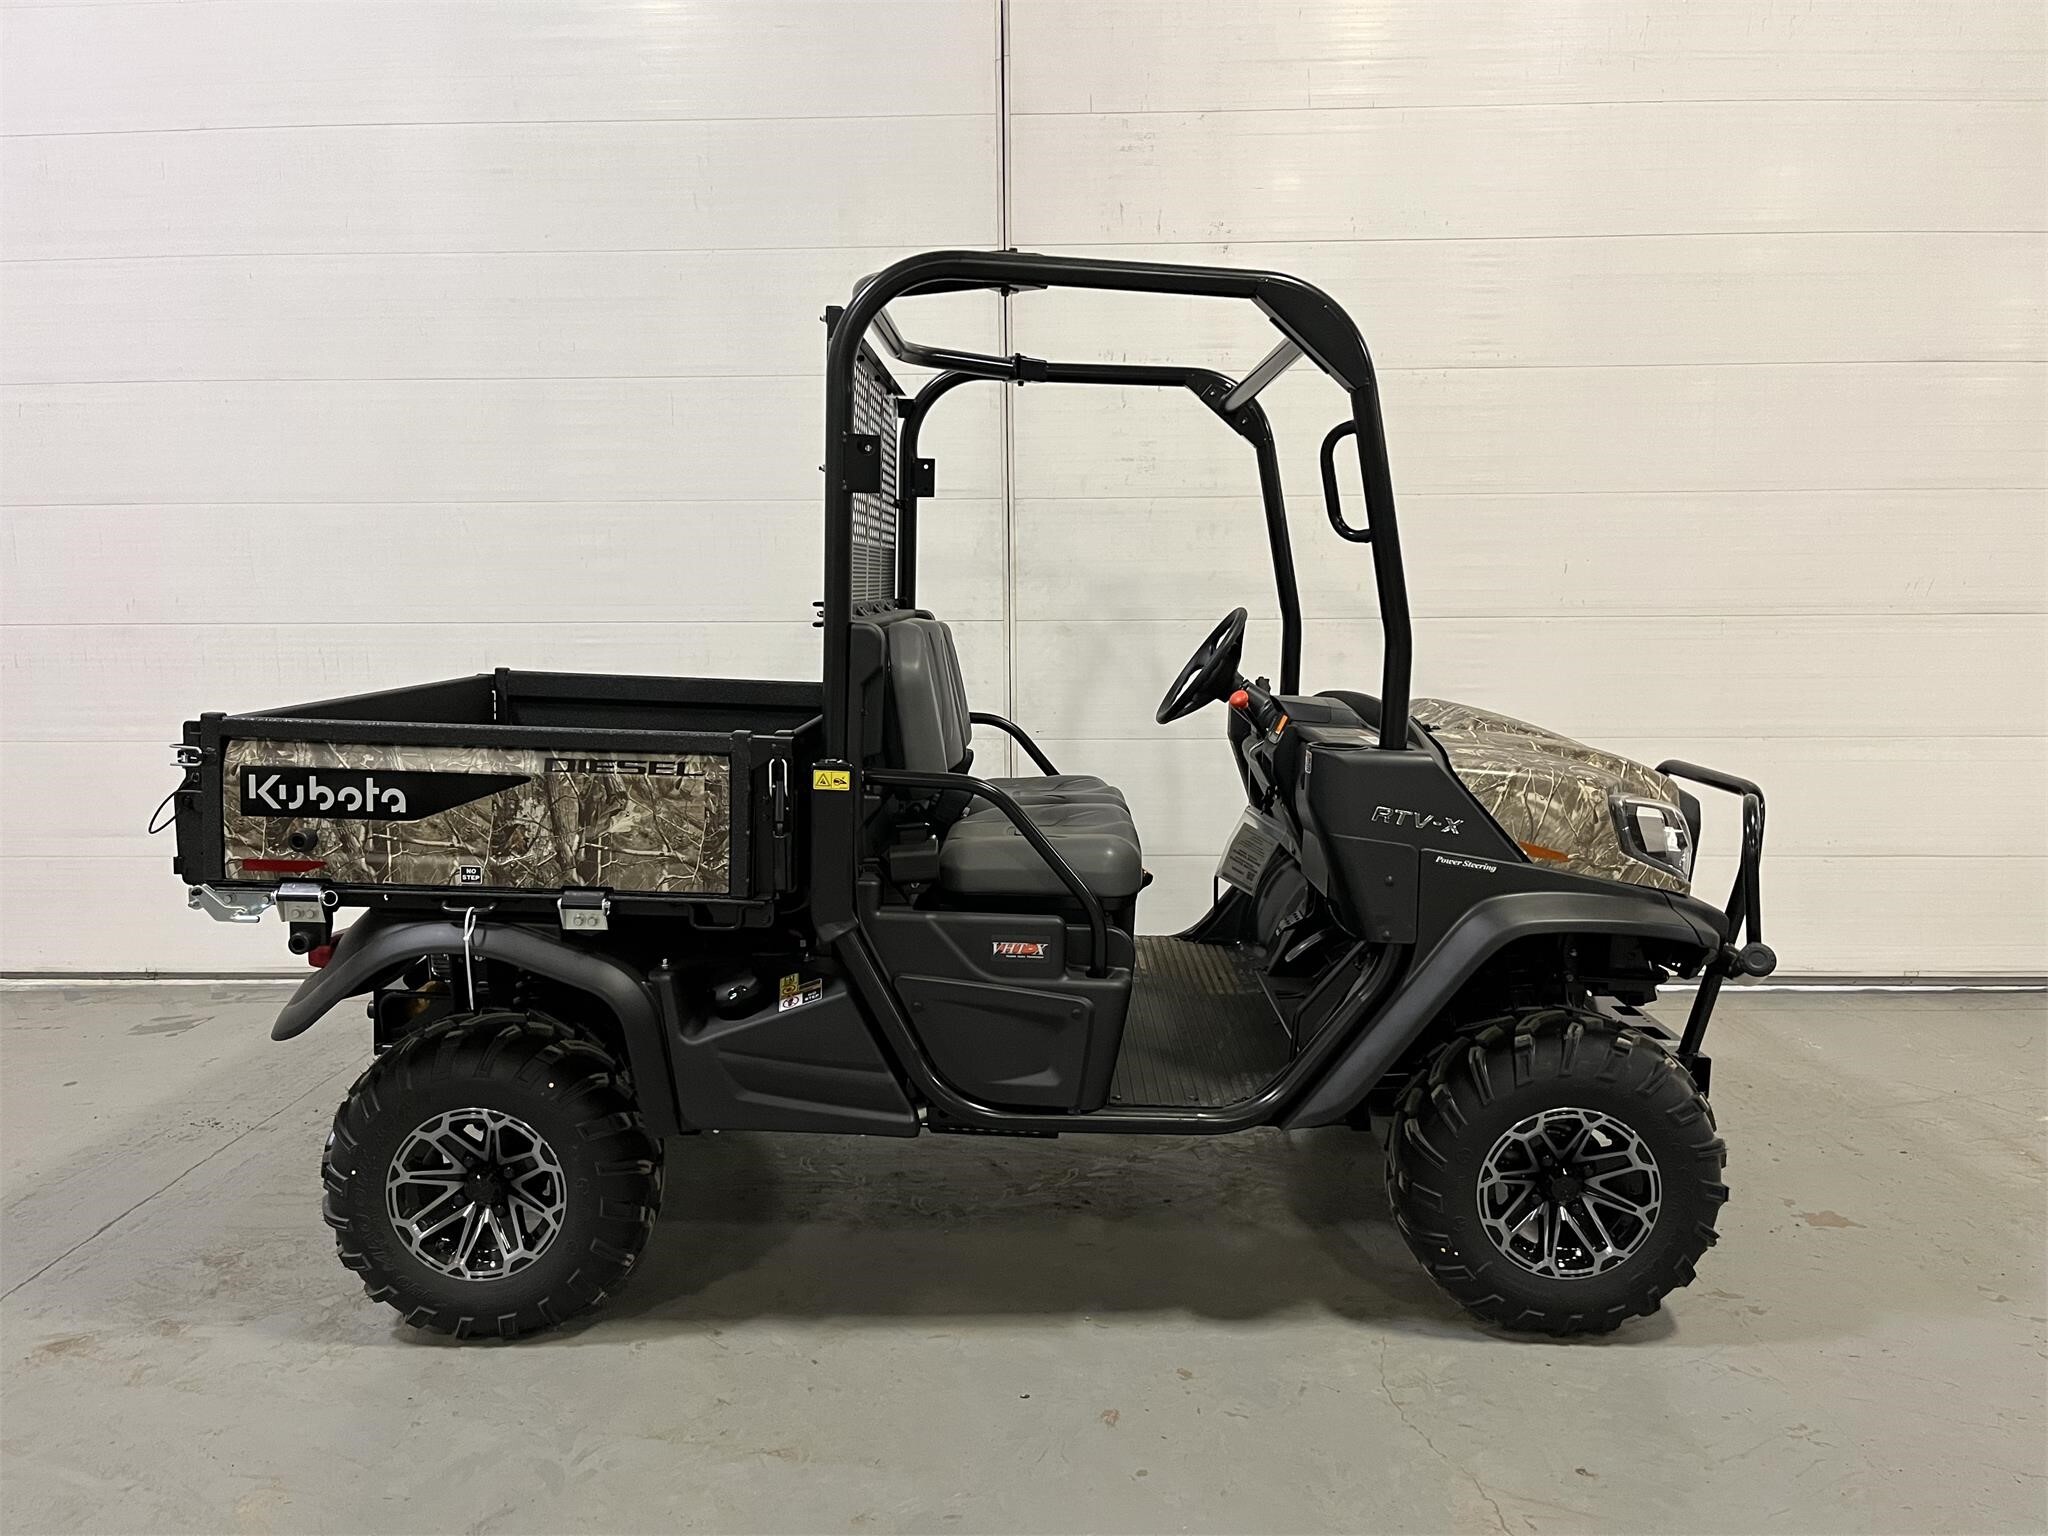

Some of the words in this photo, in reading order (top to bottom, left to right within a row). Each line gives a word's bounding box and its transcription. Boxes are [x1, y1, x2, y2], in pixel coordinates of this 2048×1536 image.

[544, 758, 705, 776] DIESEL
[248, 774, 407, 813] Kubota
[1371, 806, 1464, 834] RTV-X
[1435, 856, 1462, 866] Power
[1462, 860, 1497, 873] Steering
